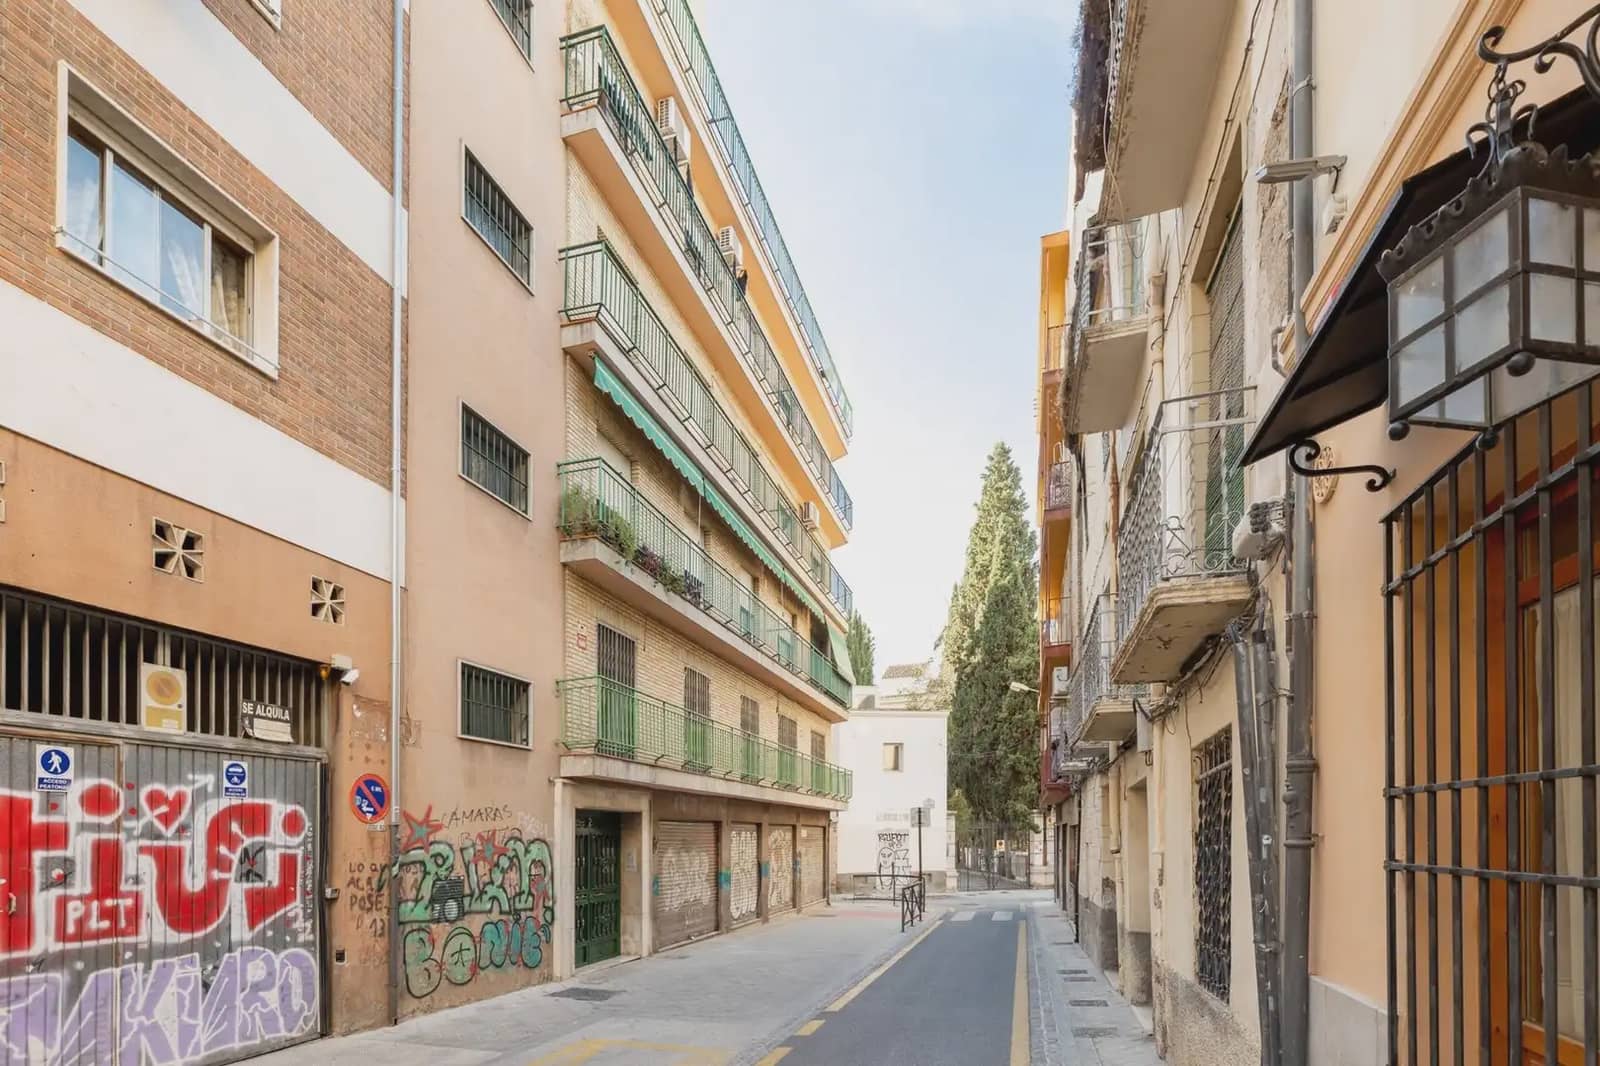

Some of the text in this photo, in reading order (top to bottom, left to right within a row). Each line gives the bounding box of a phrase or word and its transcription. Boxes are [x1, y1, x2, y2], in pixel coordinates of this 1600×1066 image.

[242, 701, 290, 721] SE ALQUILA
[65, 897, 134, 935] PLT
